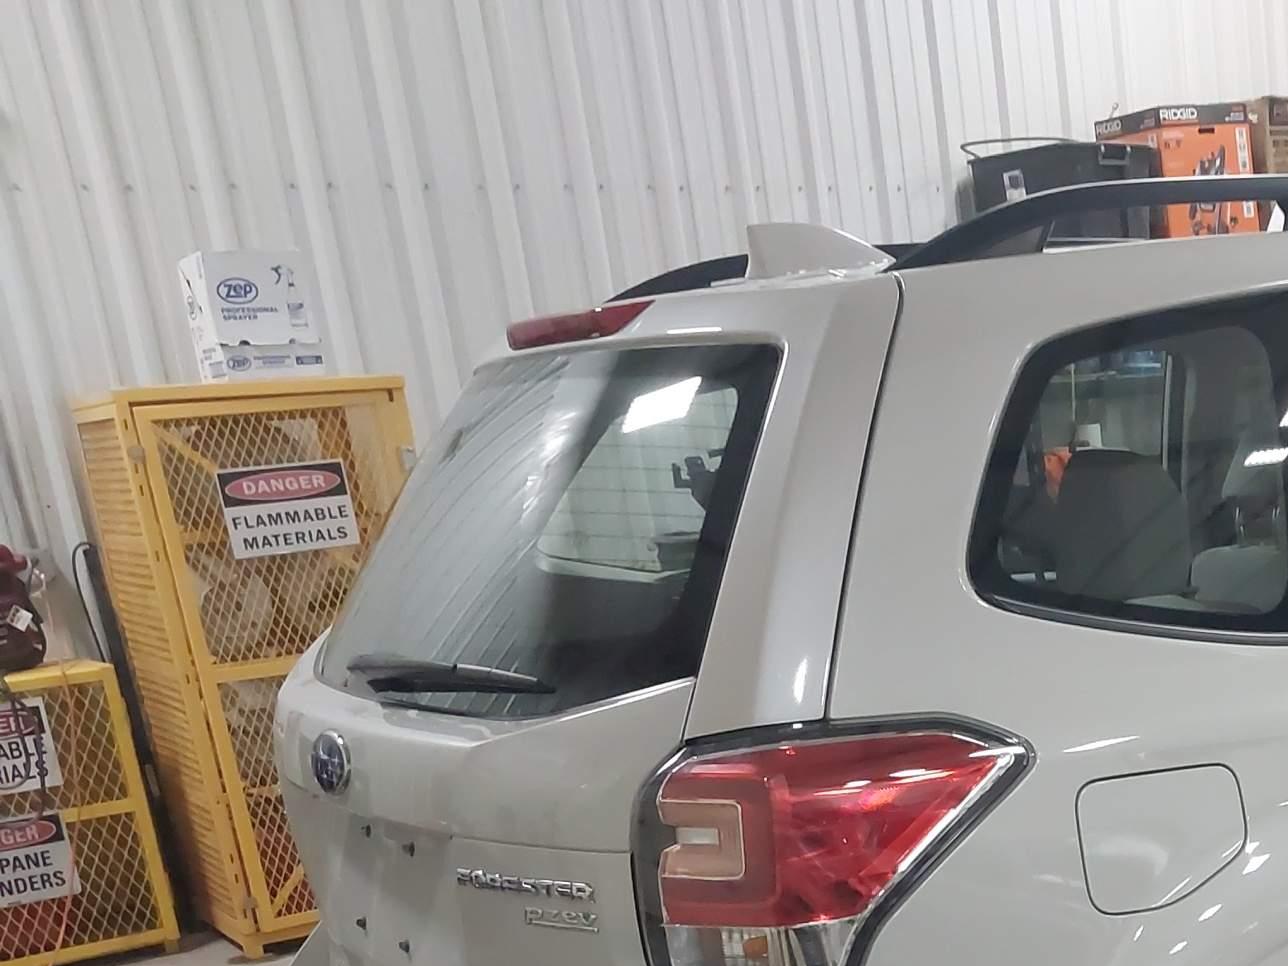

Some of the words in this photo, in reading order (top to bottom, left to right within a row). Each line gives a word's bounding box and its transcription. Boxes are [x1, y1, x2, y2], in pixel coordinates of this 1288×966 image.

[1158, 108, 1198, 121] RIDGID
[242, 474, 326, 496] DANGER
[231, 504, 349, 531] FLAMMABLE
[242, 526, 349, 551] MATERIALS
